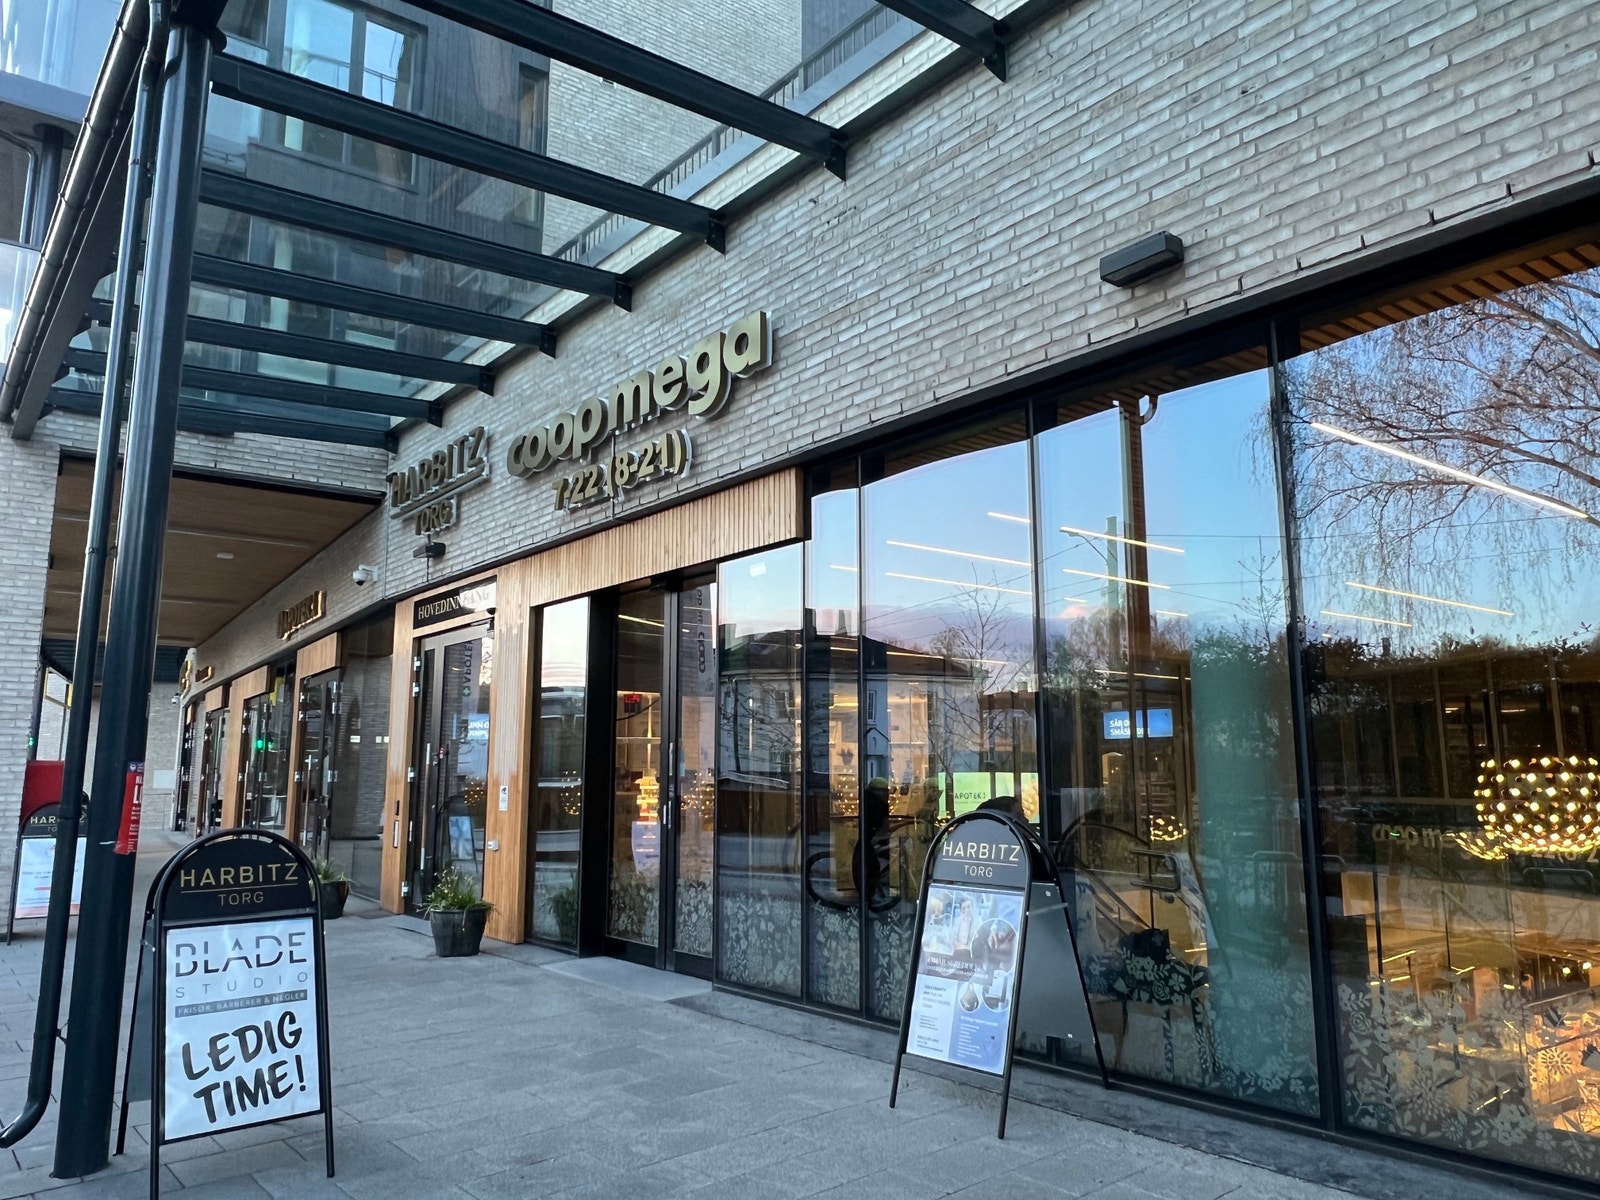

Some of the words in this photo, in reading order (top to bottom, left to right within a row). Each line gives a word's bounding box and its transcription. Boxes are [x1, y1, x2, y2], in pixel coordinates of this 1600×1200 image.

[506, 397, 608, 478] coop
[607, 310, 771, 433] mega
[391, 425, 488, 508] HARBITZ
[607, 428, 692, 499] (8-21)
[415, 498, 455, 536] TORG
[942, 841, 1021, 862] HARBITZ
[963, 864, 993, 878] TORG
[180, 862, 299, 888] HARBITZ
[217, 891, 265, 907] TORG
[175, 931, 308, 978] BLADE
[175, 971, 308, 999] STUDIO
[182, 1010, 303, 1081] LEDIG
[192, 1054, 307, 1124] TIME!
